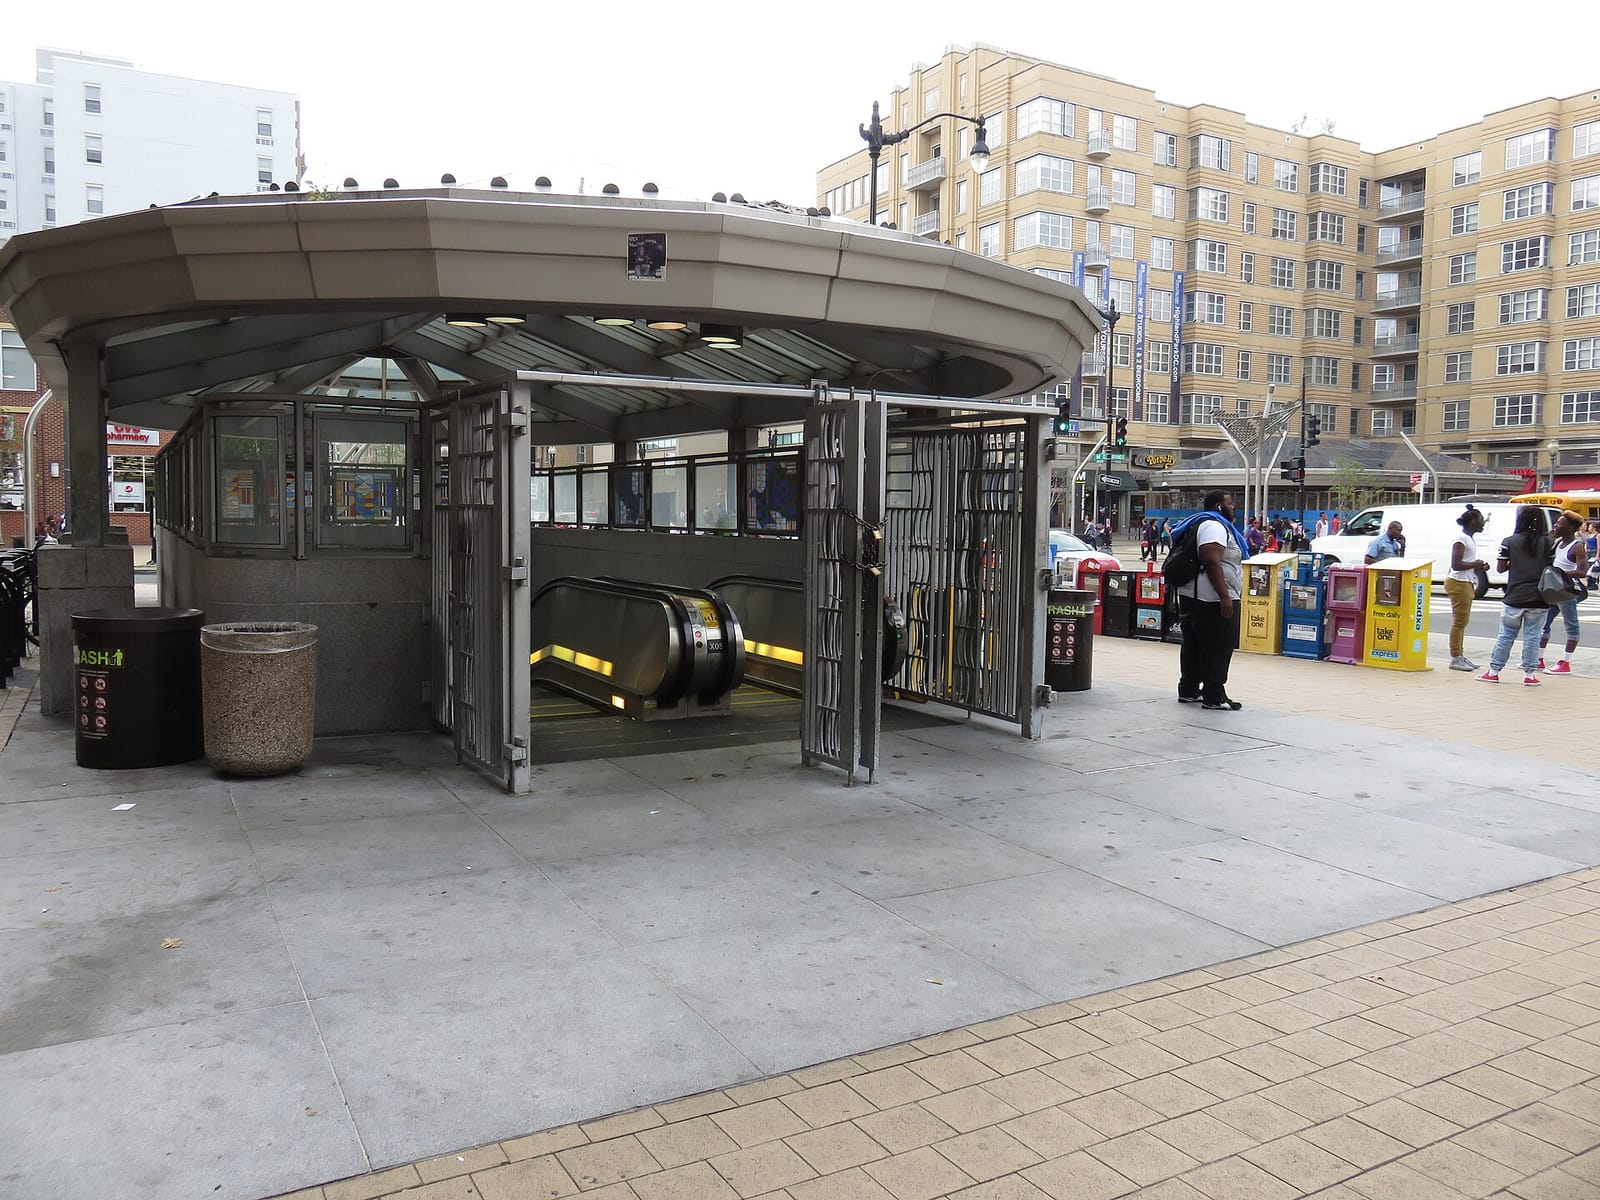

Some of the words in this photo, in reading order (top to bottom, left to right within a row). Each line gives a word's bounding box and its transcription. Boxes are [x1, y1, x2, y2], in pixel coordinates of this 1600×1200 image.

[1047, 603, 1079, 617] RASH
[1415, 585, 1423, 631] express
[1251, 614, 1265, 622] take
[1386, 611, 1401, 619] daily
[1377, 627, 1394, 635] take
[74, 646, 109, 666] ASH
[1371, 651, 1399, 659] express
